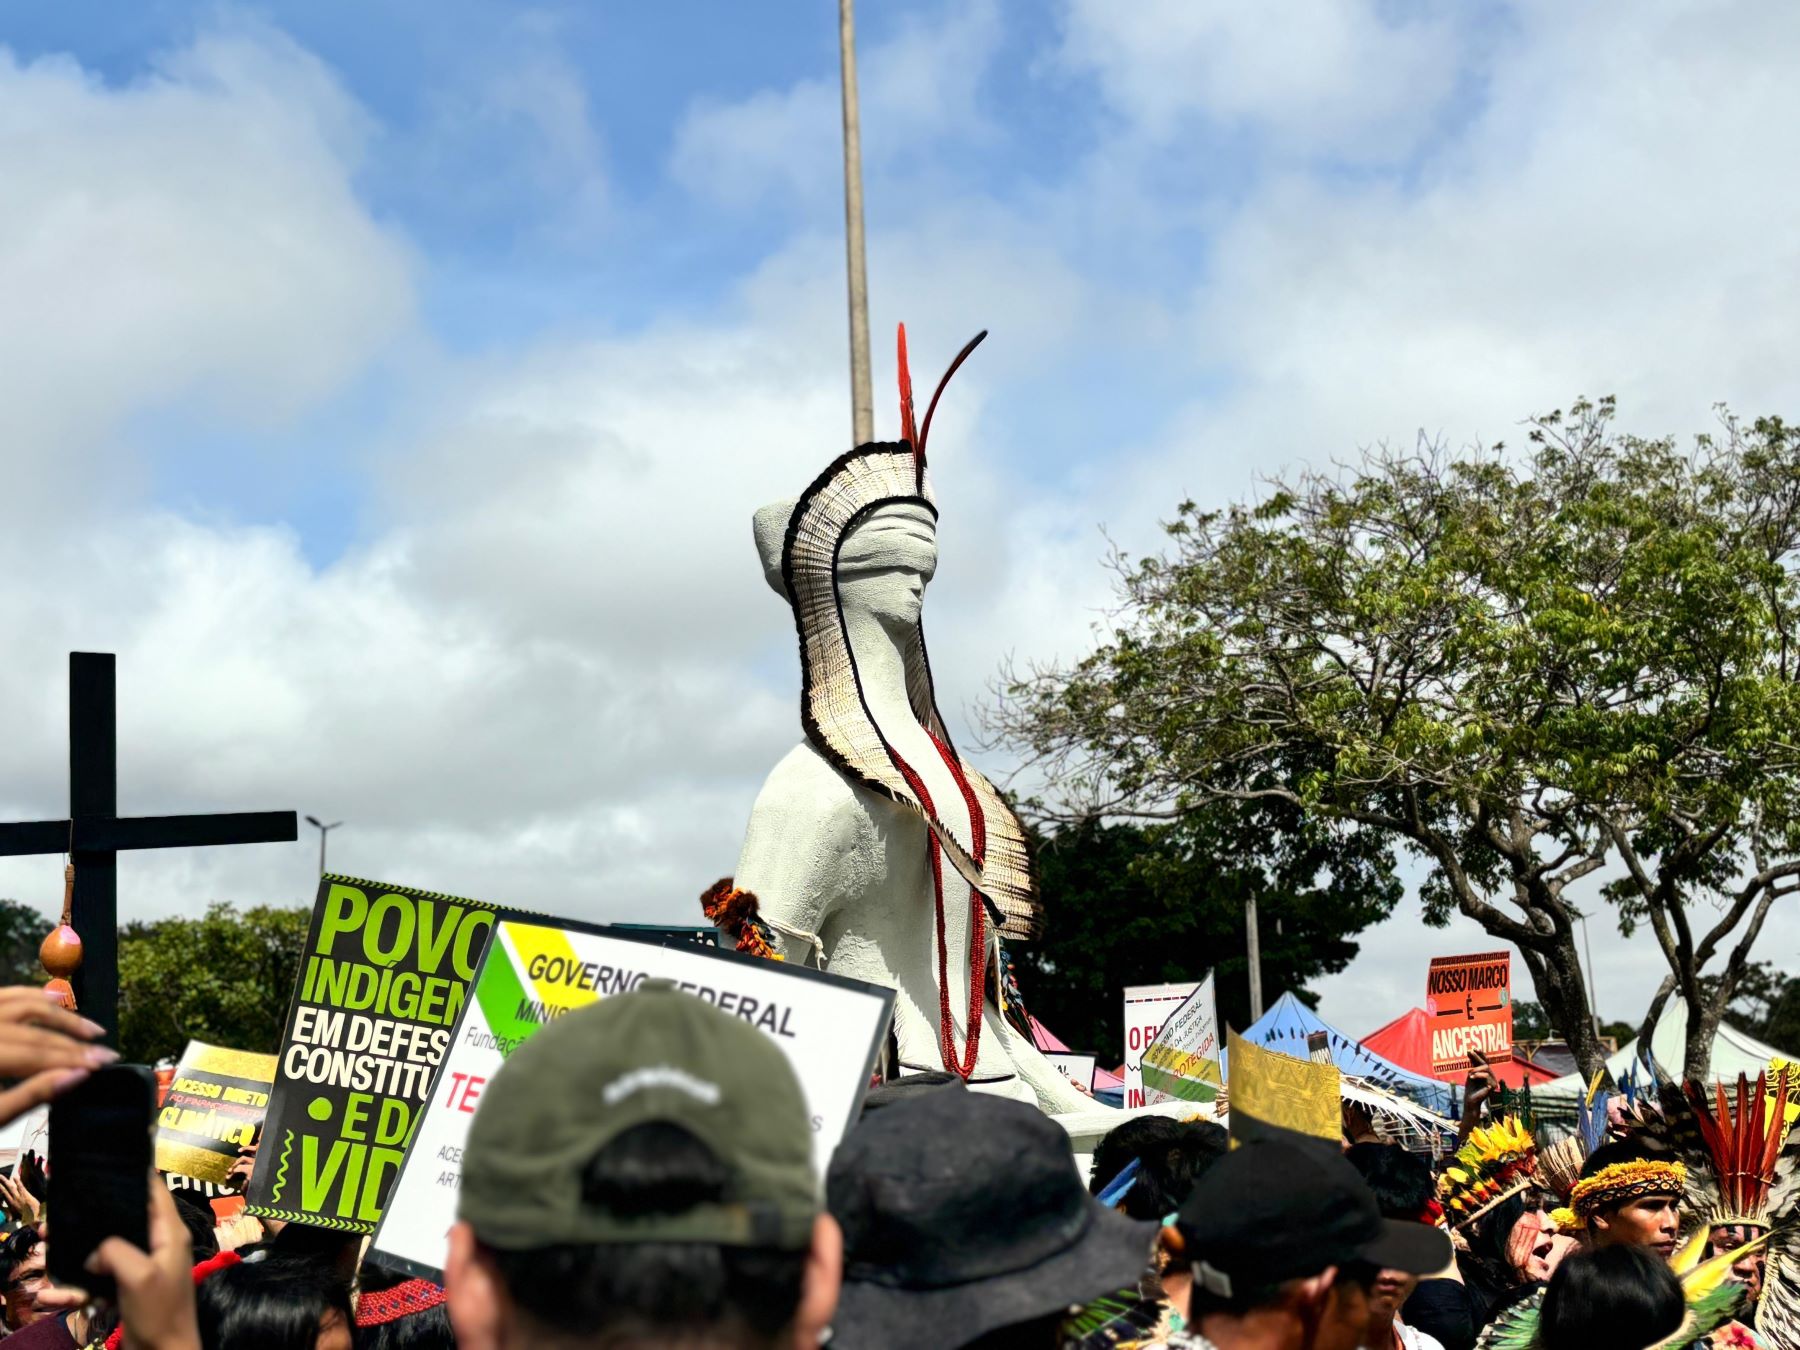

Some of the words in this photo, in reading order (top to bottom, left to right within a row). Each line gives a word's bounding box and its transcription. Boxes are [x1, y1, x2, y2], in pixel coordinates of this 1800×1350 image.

[316, 883, 496, 982] POVO
[1428, 968, 1467, 995] NOSSO
[1468, 964, 1507, 990] MARCO
[1466, 993, 1474, 1020] É
[292, 1005, 346, 1049] EM
[346, 1015, 450, 1066] DEFES
[1129, 1027, 1141, 1050] O
[1432, 1021, 1510, 1060] ANCESTRAL
[172, 1077, 221, 1099] ACESSO
[445, 1071, 486, 1114] TE
[341, 1092, 374, 1141] E
